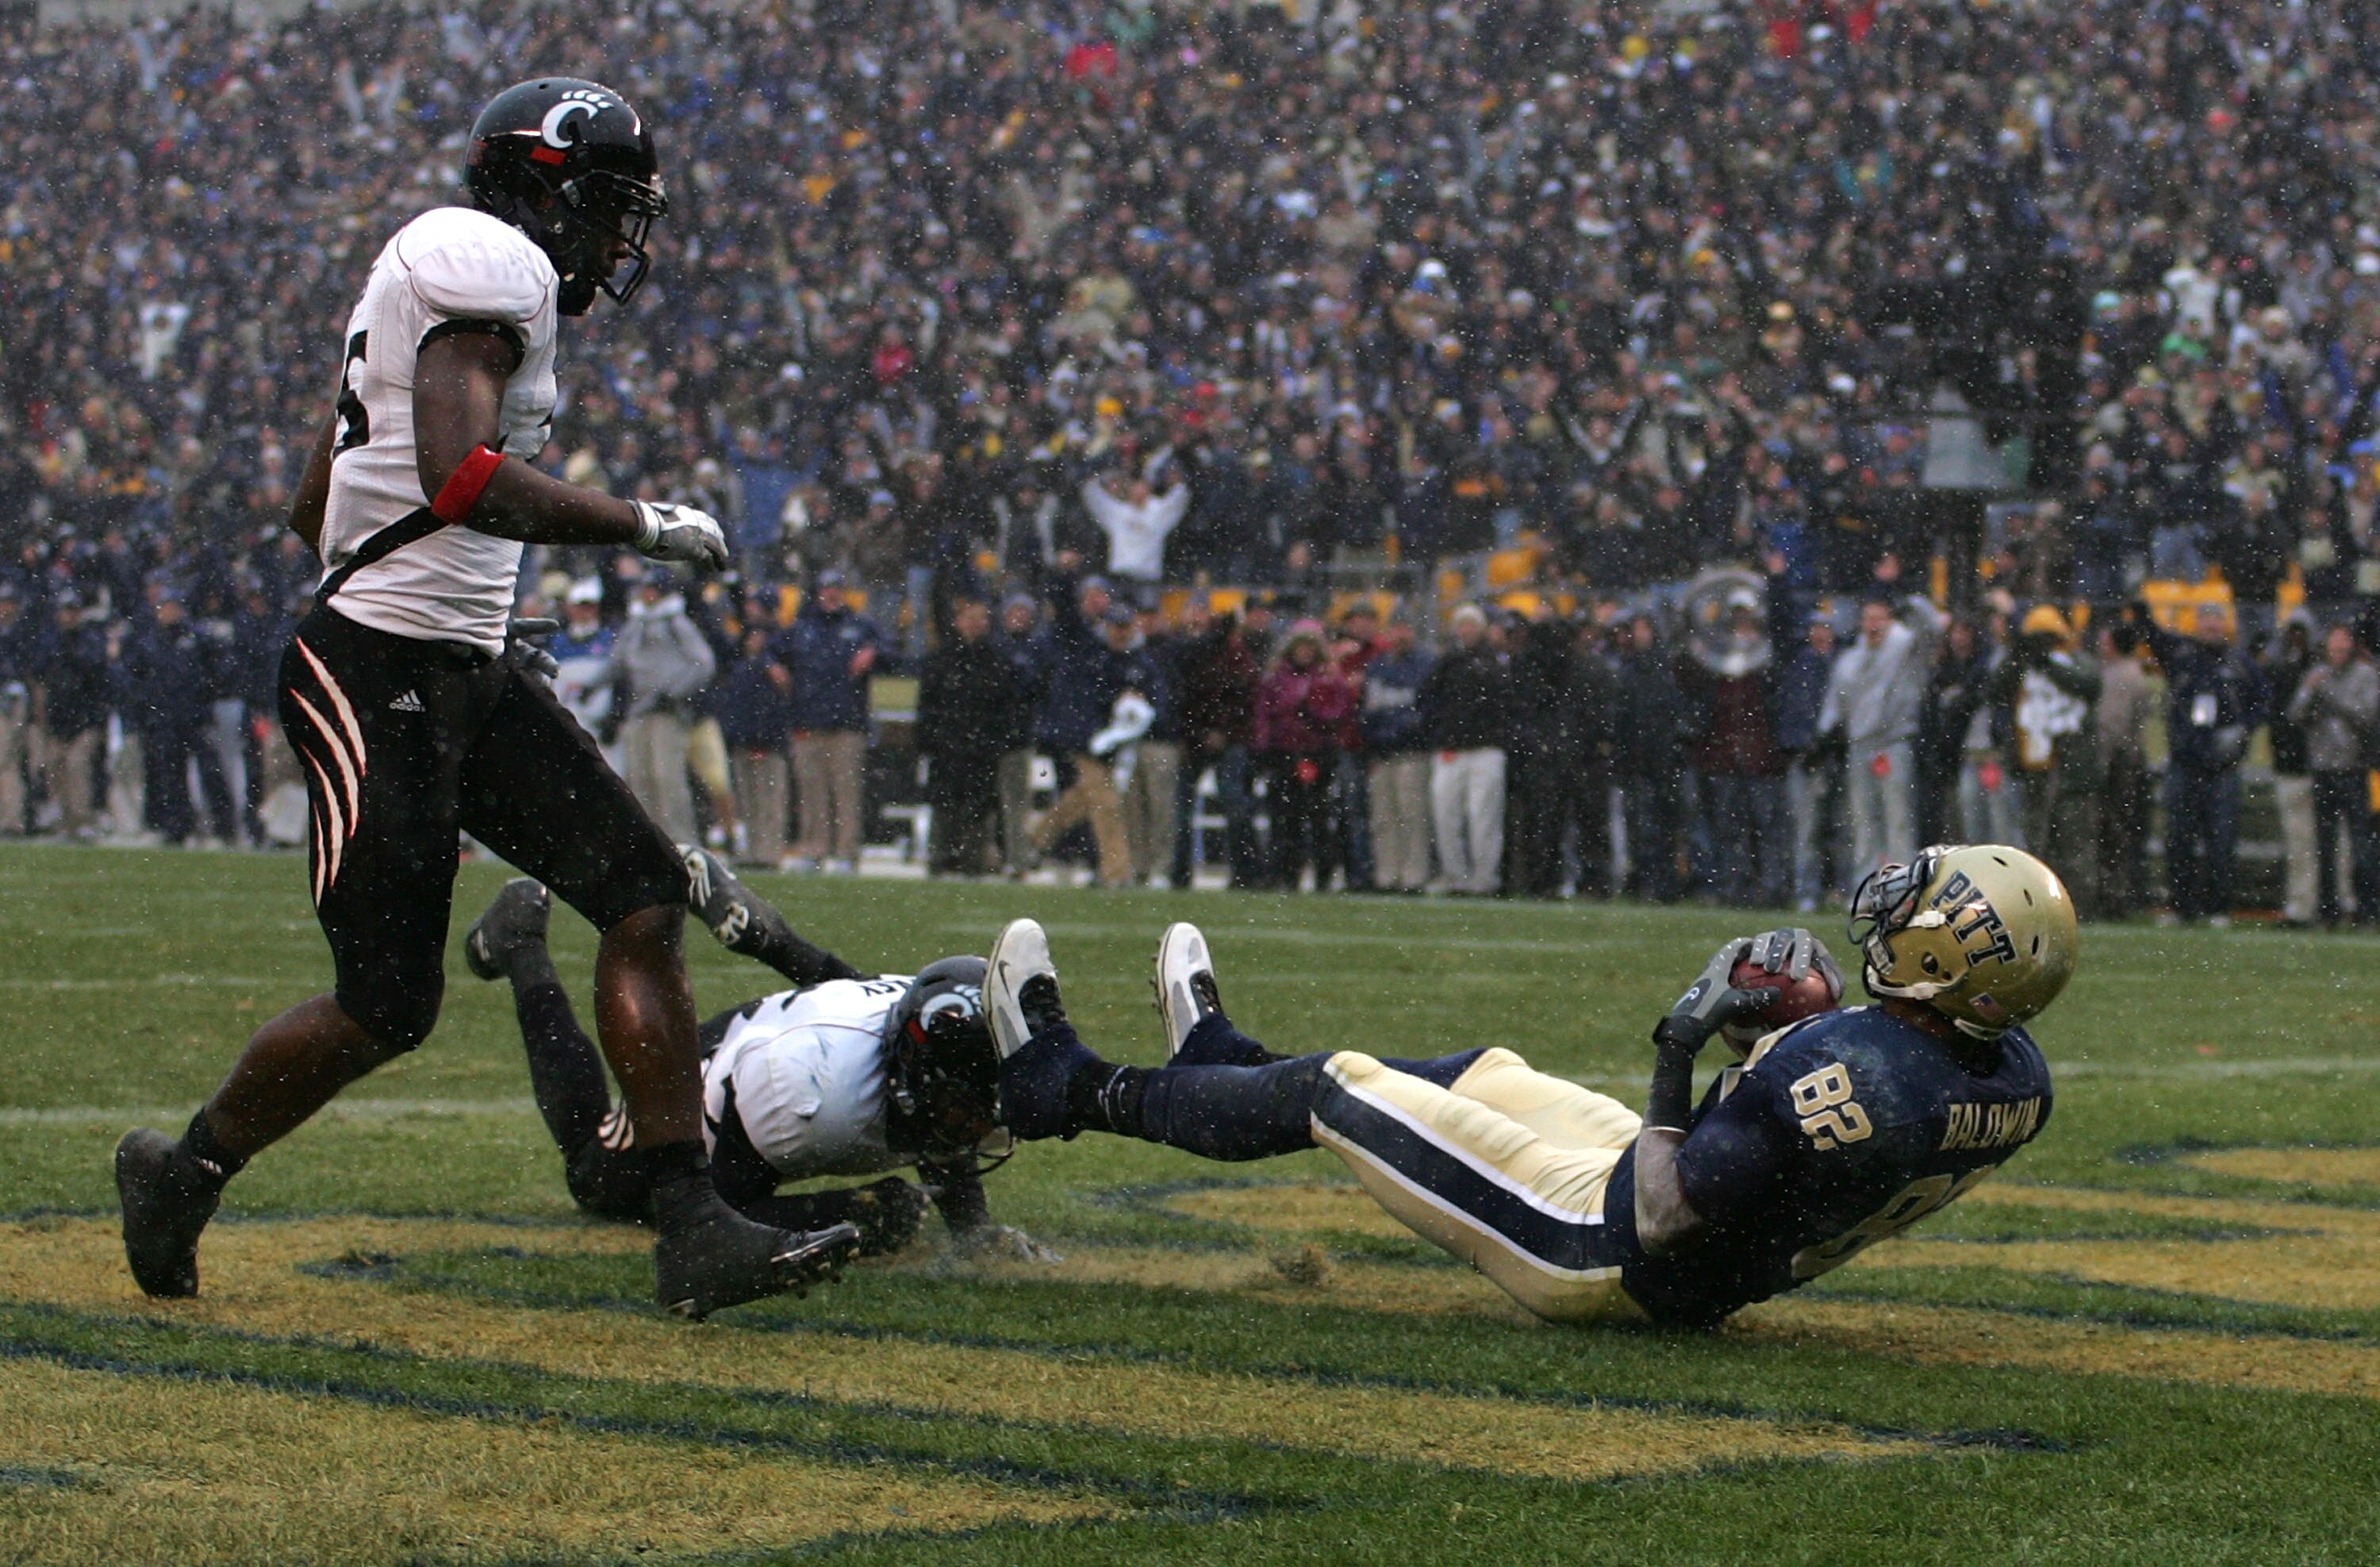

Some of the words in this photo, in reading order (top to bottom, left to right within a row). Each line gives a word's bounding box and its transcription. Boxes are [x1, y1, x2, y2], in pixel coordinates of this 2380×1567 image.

[1929, 870, 2017, 967] PITT
[1789, 1062, 1873, 1151] 82
[1940, 1096, 2042, 1151] BALDWIN
